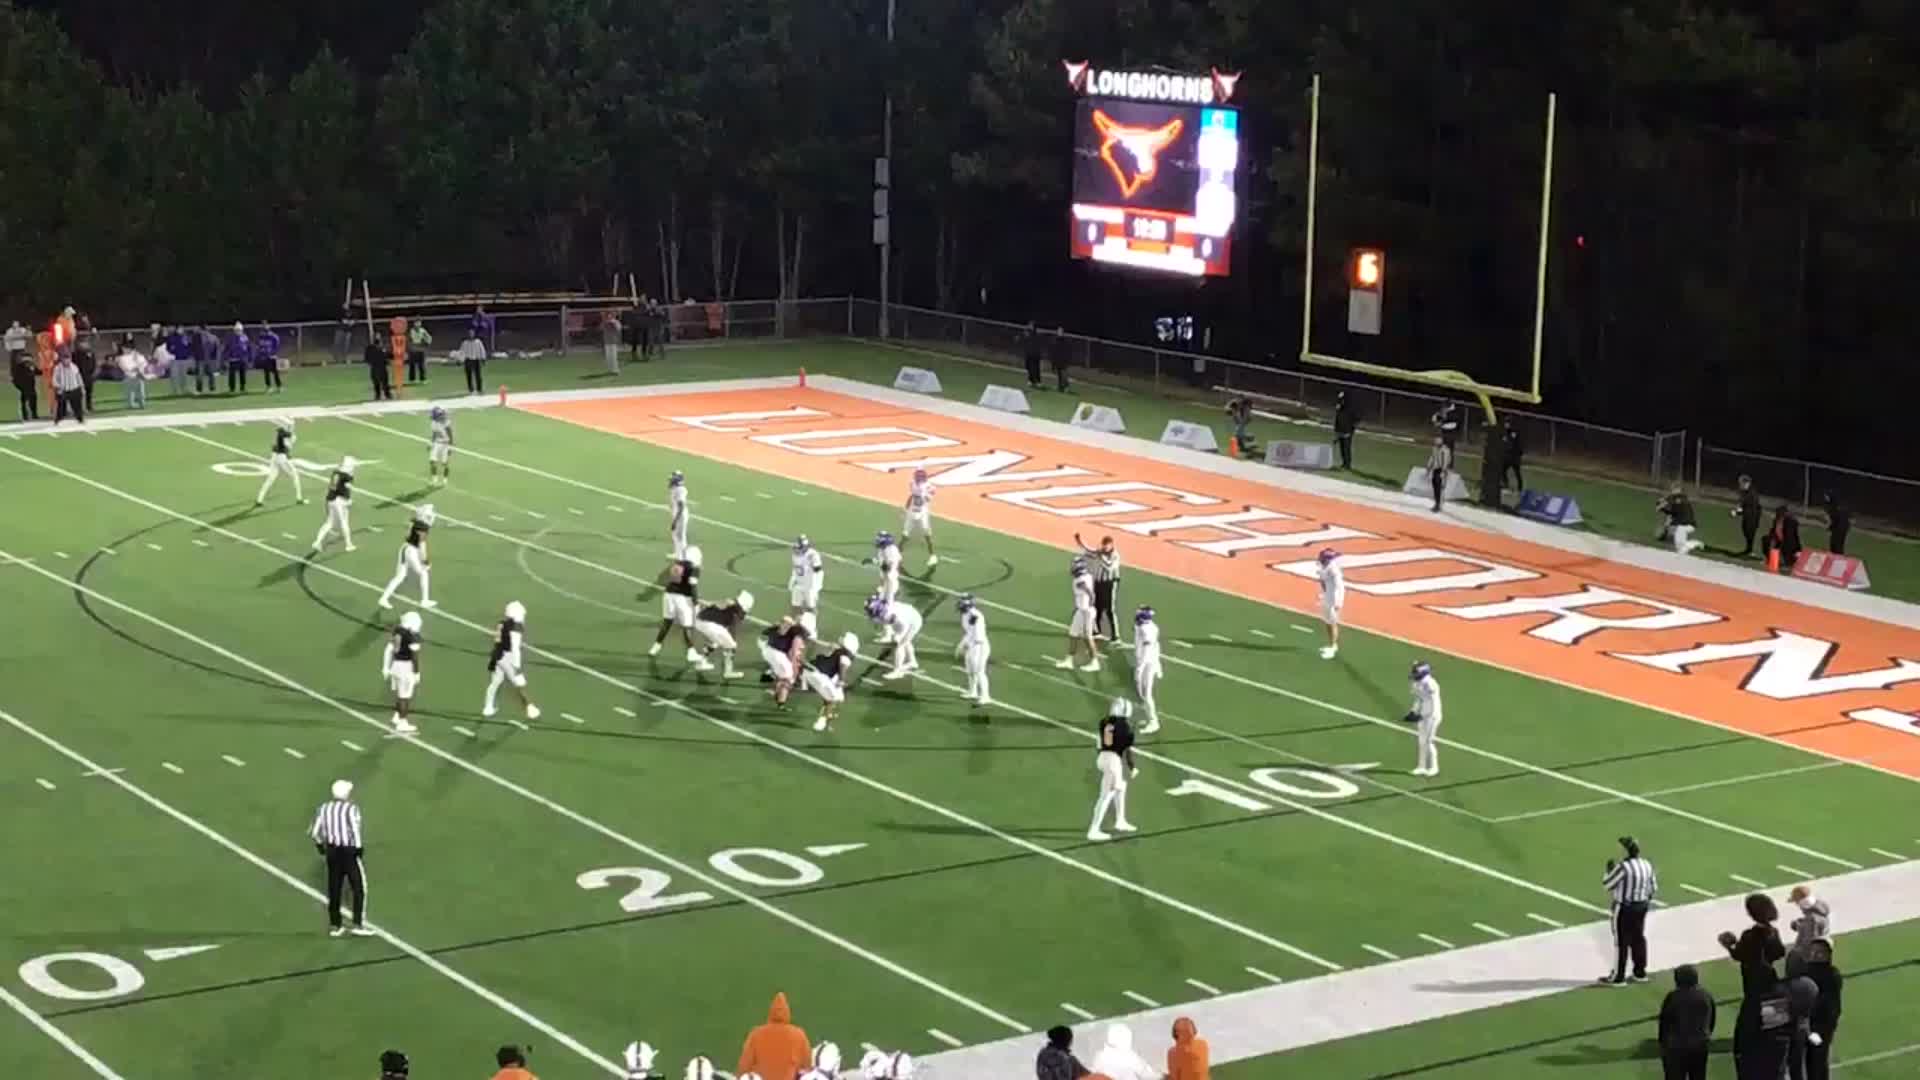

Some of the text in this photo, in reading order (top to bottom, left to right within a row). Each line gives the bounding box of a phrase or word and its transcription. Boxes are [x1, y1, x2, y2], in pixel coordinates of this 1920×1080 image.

[1087, 69, 1215, 103] LONGHORNS
[1361, 254, 1378, 283] 6
[1165, 768, 1359, 811] 10
[577, 847, 825, 913] 20
